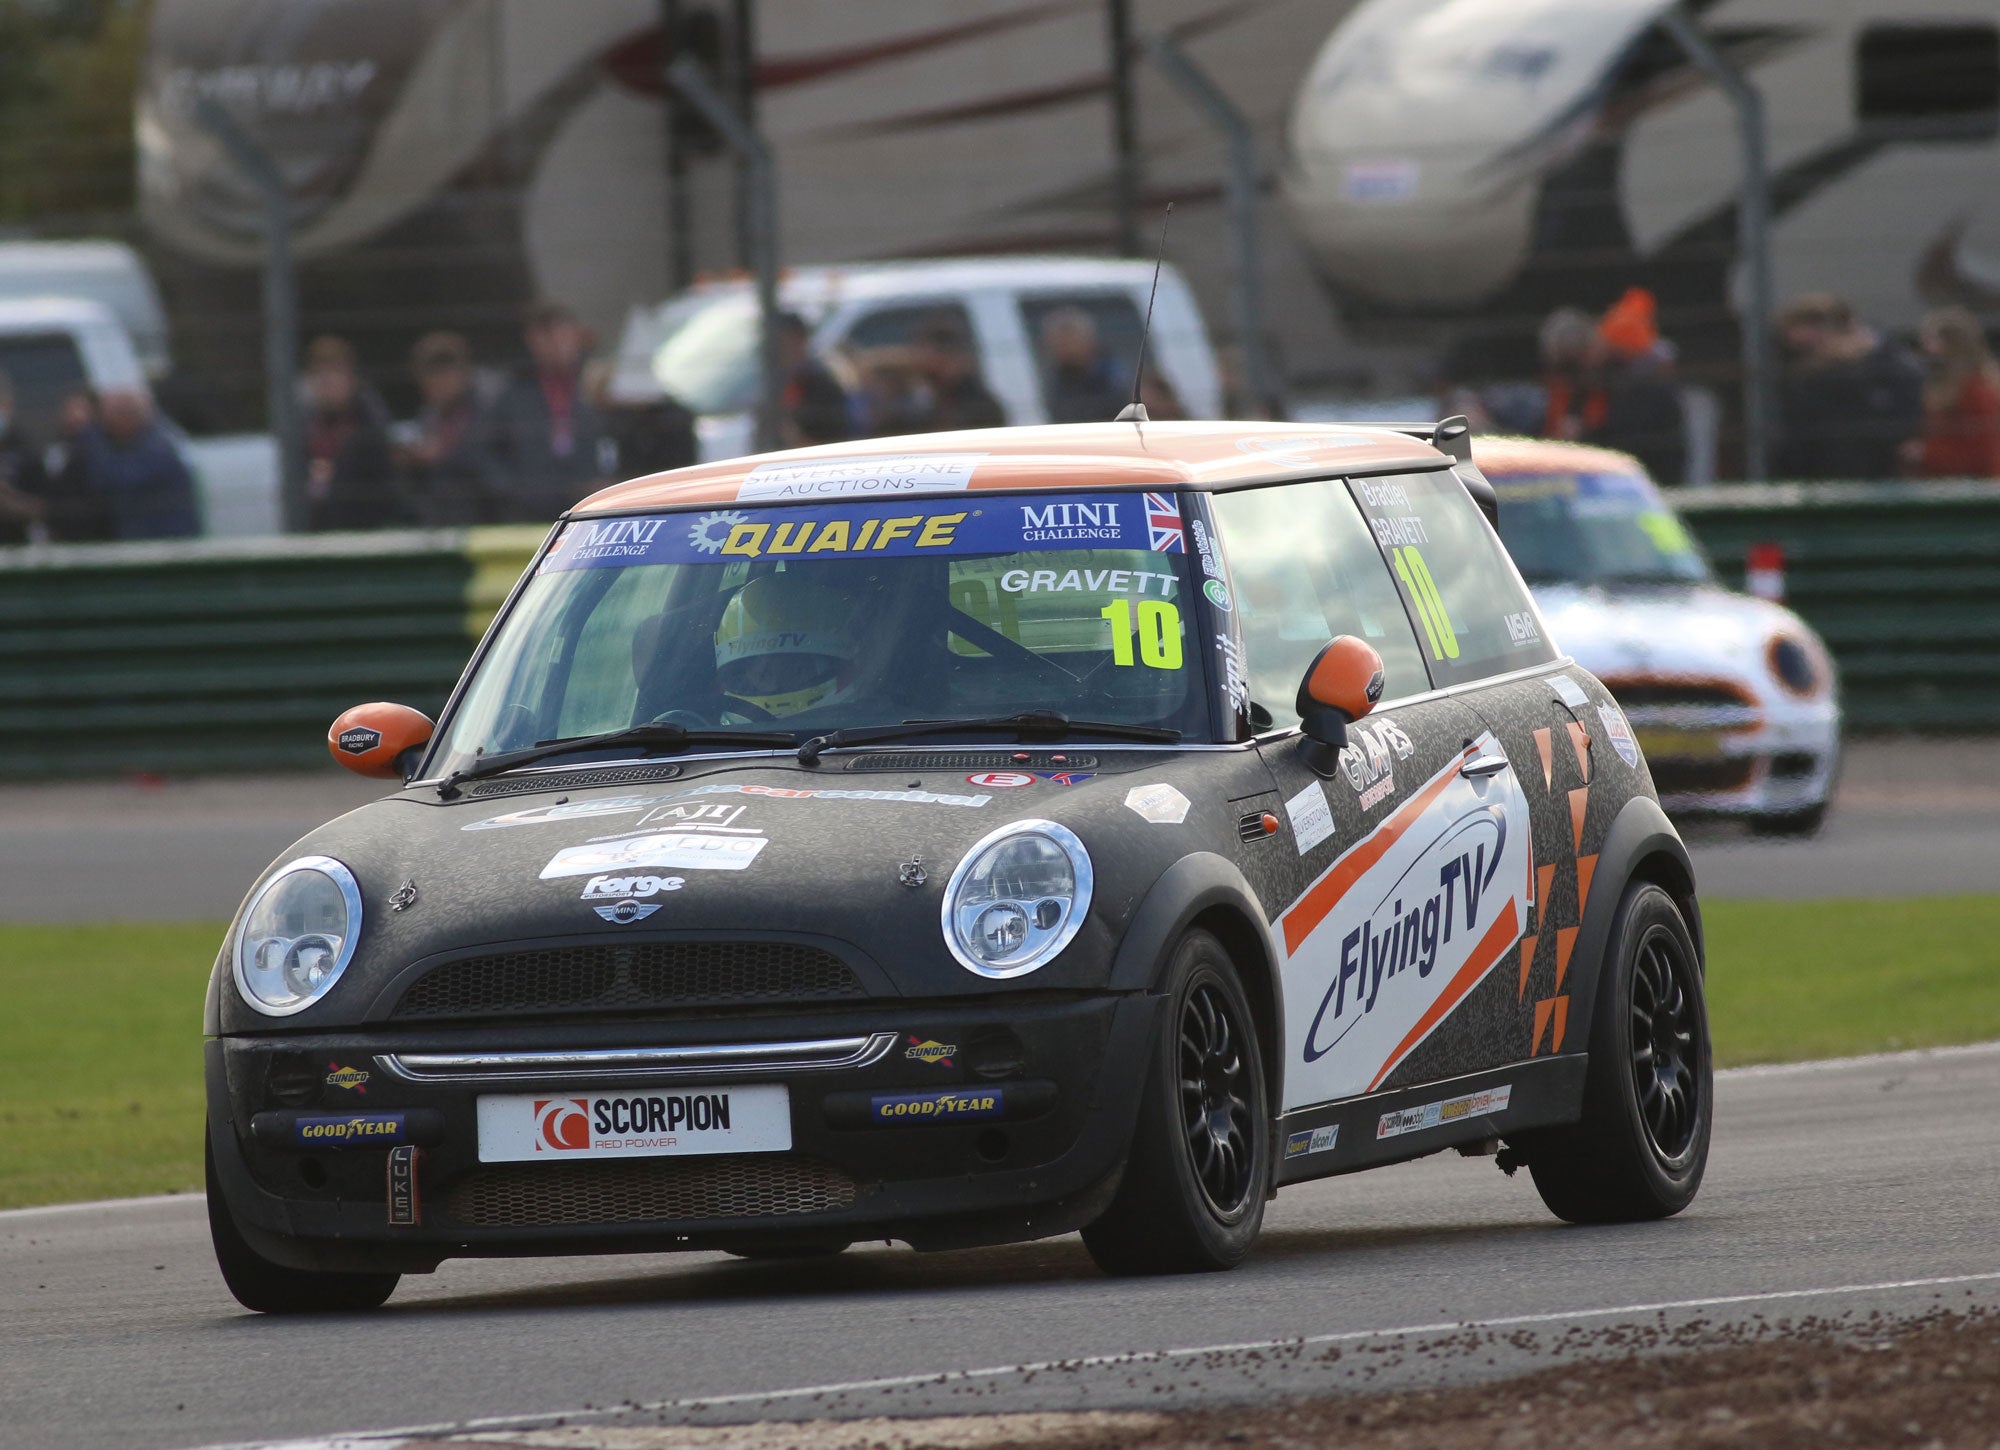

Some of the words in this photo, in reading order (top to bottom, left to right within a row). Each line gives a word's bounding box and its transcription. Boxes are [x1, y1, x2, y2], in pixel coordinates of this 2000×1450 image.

[778, 478, 917, 498] AUCTIONS
[1359, 479, 1412, 513] Bradley
[1020, 503, 1121, 530] MINI
[578, 519, 667, 548] MINI
[719, 511, 969, 560] QUAIFE
[1023, 528, 1121, 542] CHALLENGE
[1369, 516, 1429, 546] GRAVETT
[572, 544, 649, 560] CHALLENGE
[1201, 553, 1216, 578] Elite
[1000, 569, 1180, 596] GRAVETT
[1391, 545, 1460, 661] 10
[1100, 598, 1184, 671] 10
[1503, 611, 1539, 641] MSVR
[341, 733, 376, 743] BRADBURY
[648, 803, 734, 822] AJI
[583, 891, 631, 899] MOTORSPORT
[615, 906, 637, 914] MINI
[1334, 842, 1485, 1020] FlyingTV
[906, 1045, 955, 1058] SUNOCO
[328, 1072, 368, 1083] SUNOCO
[593, 1094, 731, 1135] SCORPION
[595, 1139, 622, 1149] RED
[625, 1137, 677, 1148] POWER
[394, 1150, 409, 1208] LUKE
